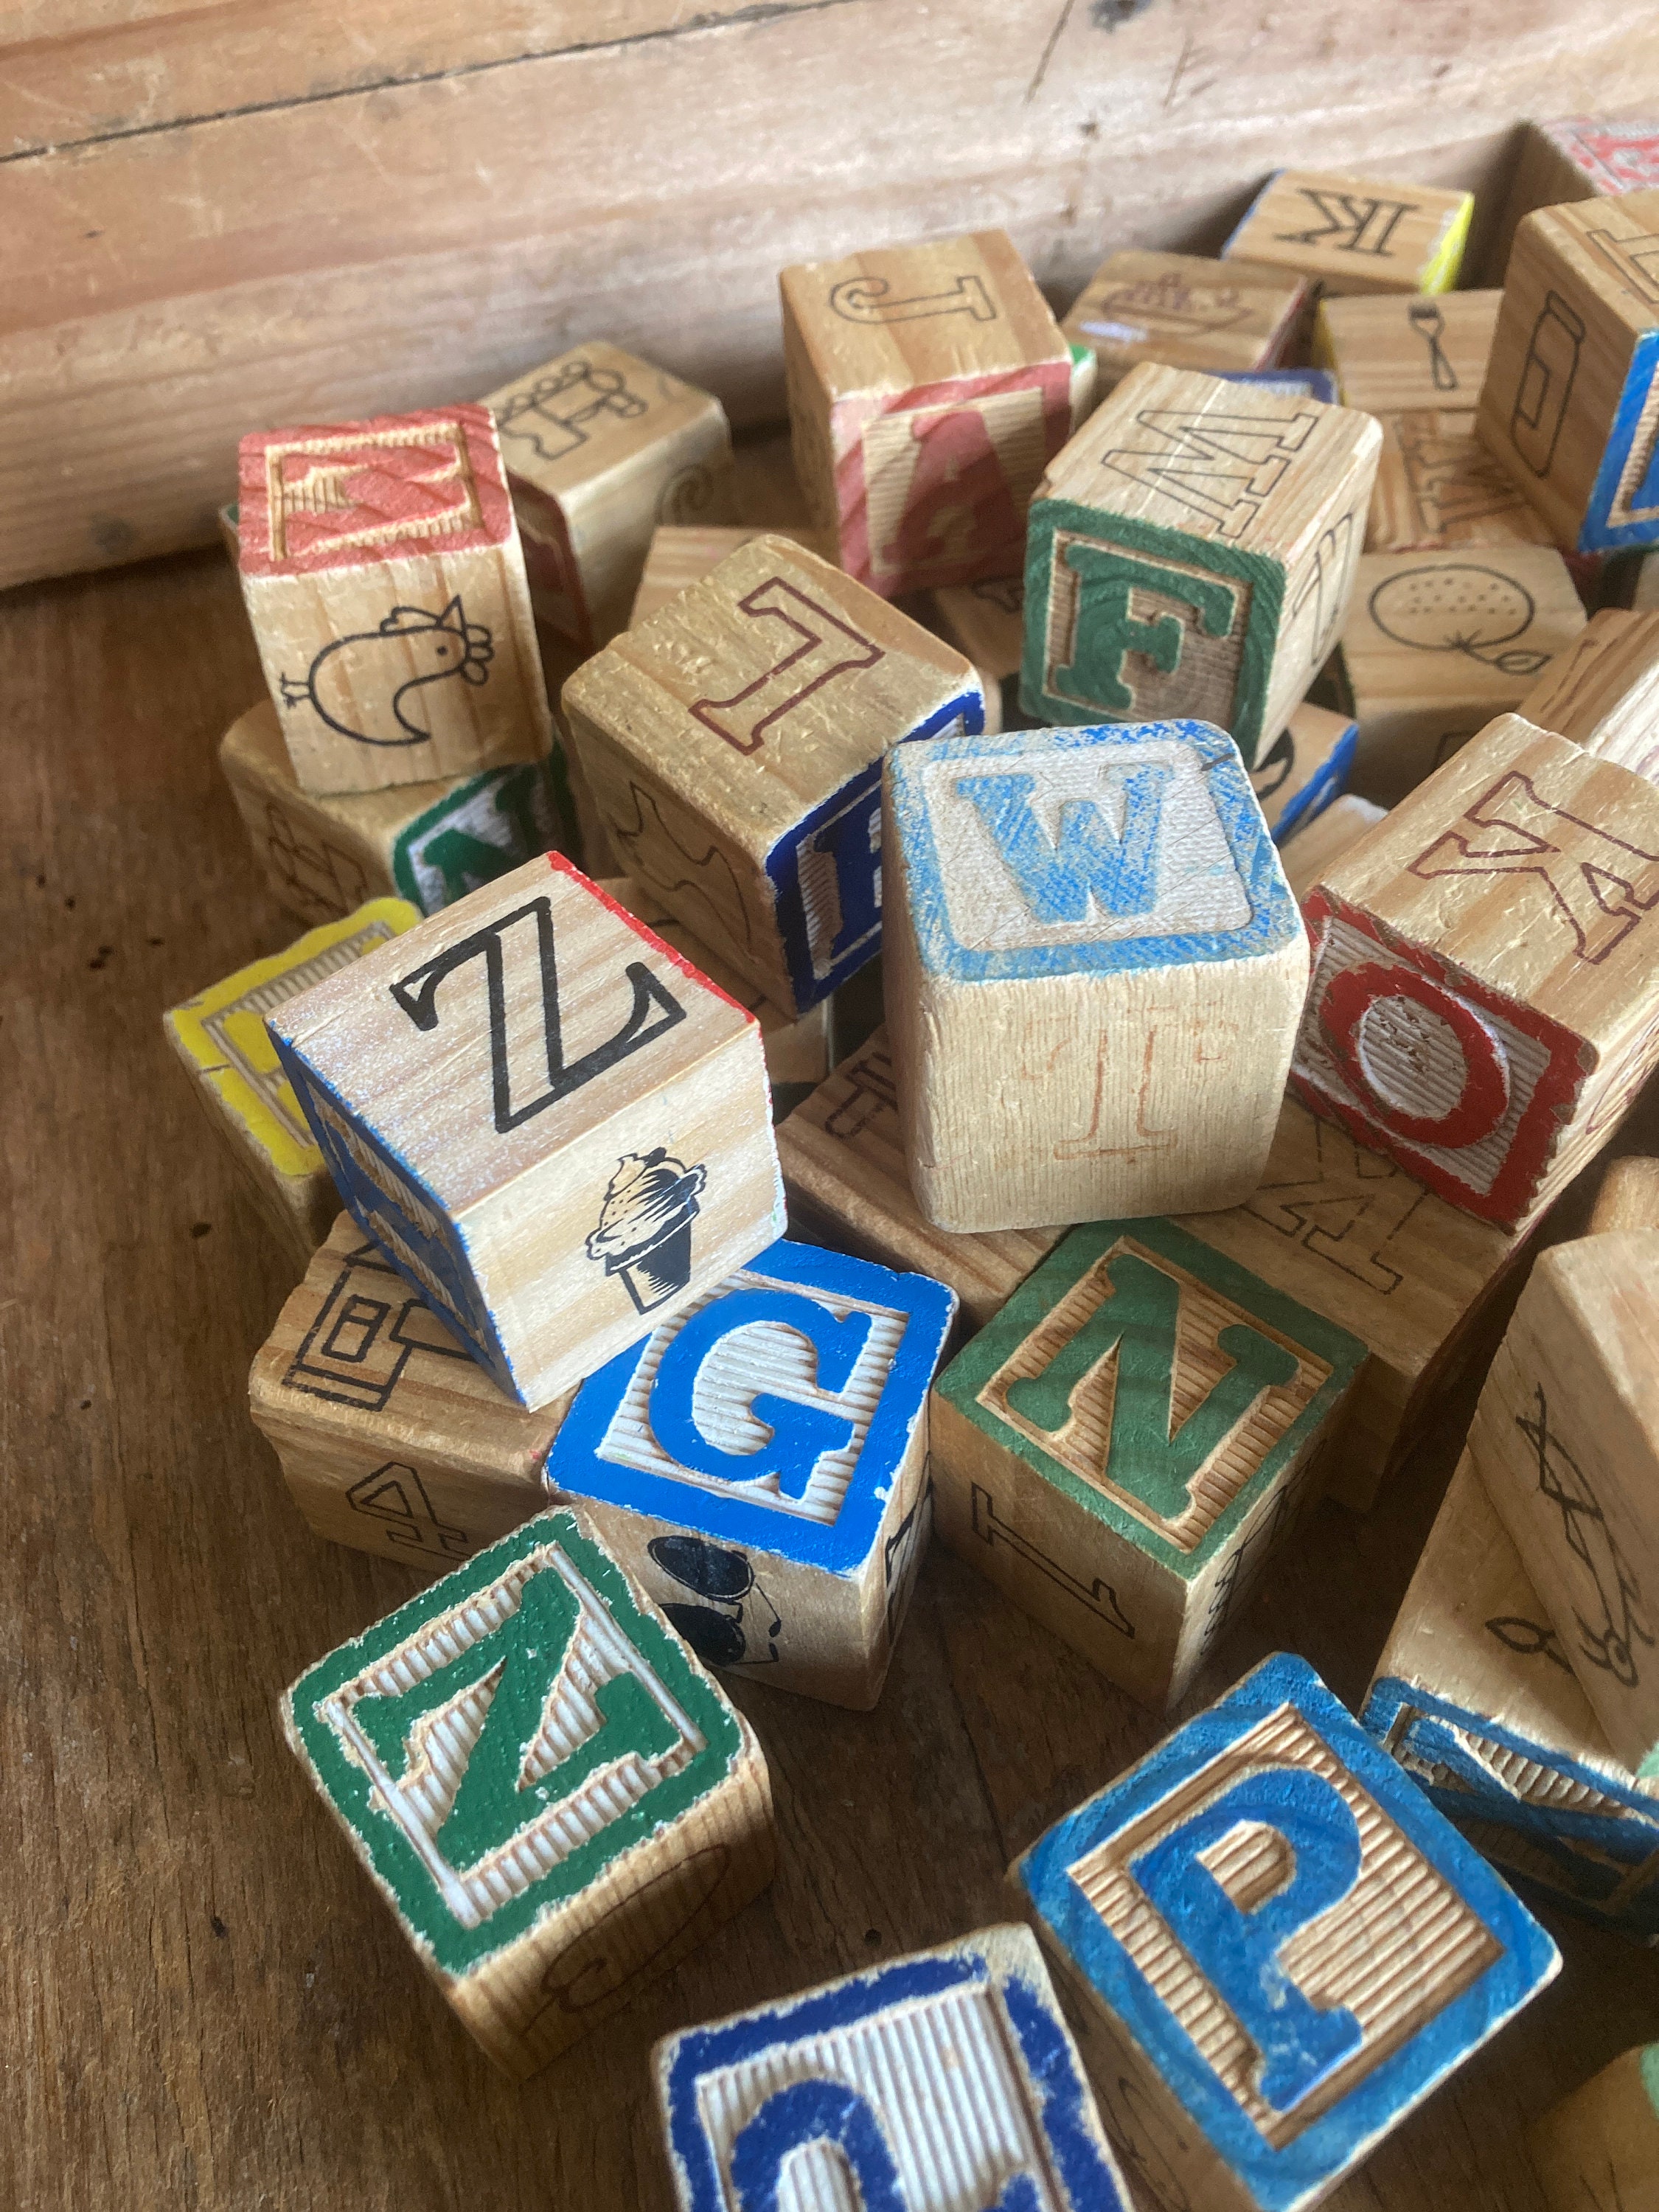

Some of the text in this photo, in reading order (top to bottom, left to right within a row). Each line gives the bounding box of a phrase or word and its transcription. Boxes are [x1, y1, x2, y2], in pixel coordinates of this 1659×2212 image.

[830, 276, 997, 324] J
[1275, 188, 1421, 257] K
[880, 410, 1032, 564] A
[1062, 541, 1234, 710] F
[956, 762, 1175, 924] W
[1406, 770, 1659, 965] K
[390, 896, 687, 1134] Z
[1021, 999, 1239, 1164] T
[1317, 961, 1509, 1149] O
[649, 1288, 873, 1504] G
[1006, 1253, 1301, 1522] N
[347, 1462, 473, 1562] 4
[1129, 1765, 1363, 2112] P
